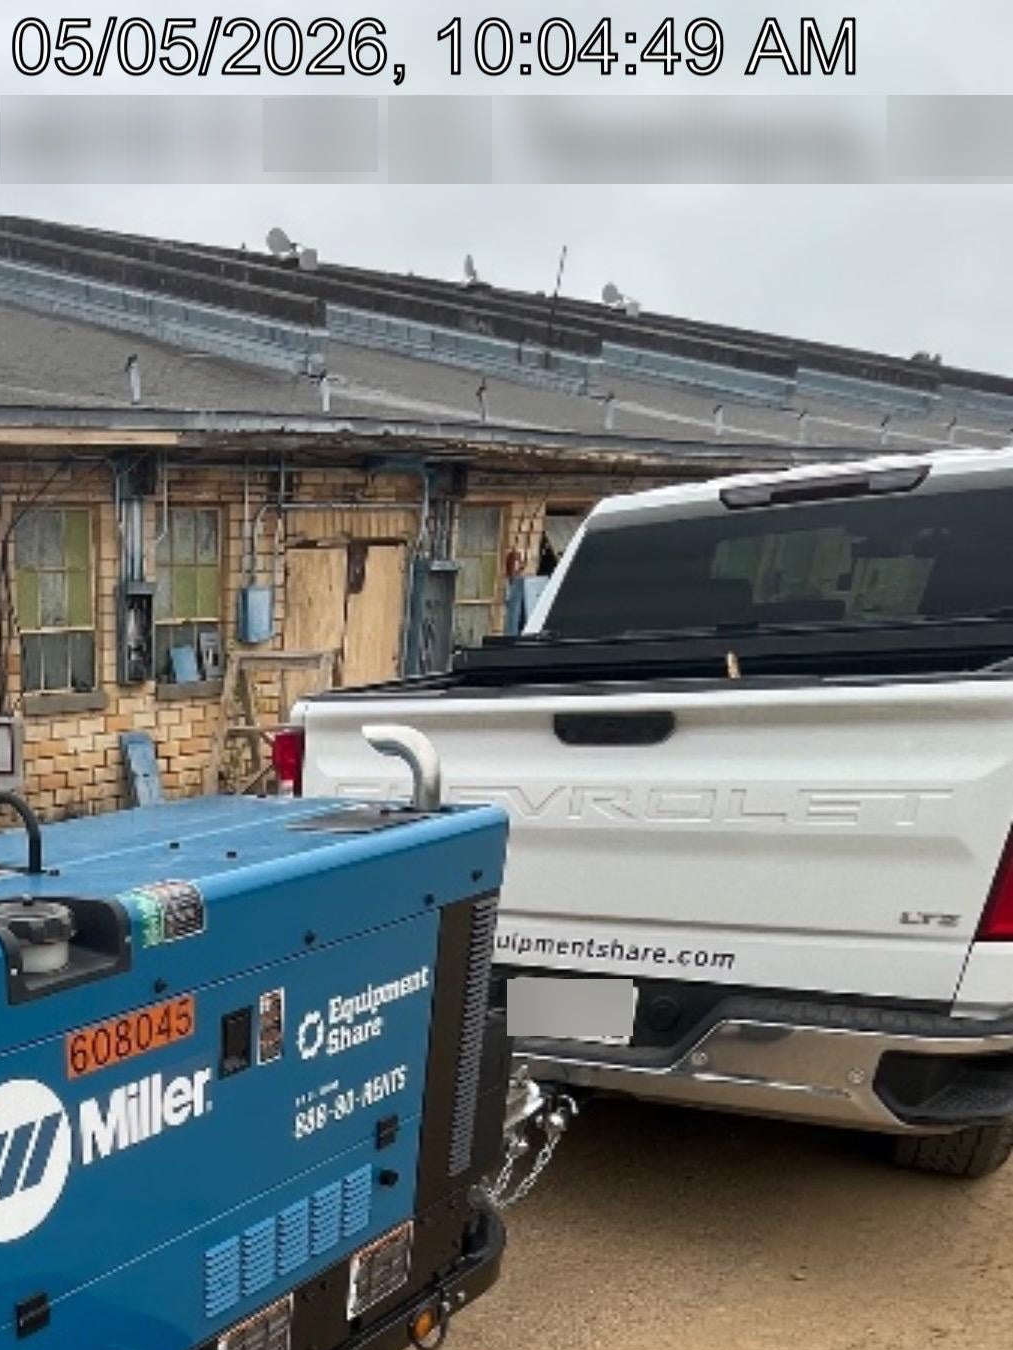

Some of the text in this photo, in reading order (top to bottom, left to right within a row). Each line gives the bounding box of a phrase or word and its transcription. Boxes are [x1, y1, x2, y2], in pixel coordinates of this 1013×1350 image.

[494, 931, 736, 970] uipmentshare.com
[328, 965, 430, 1026] Equipment
[69, 998, 193, 1075] 608045
[325, 1016, 383, 1056] Share
[79, 1067, 212, 1166] Miller
